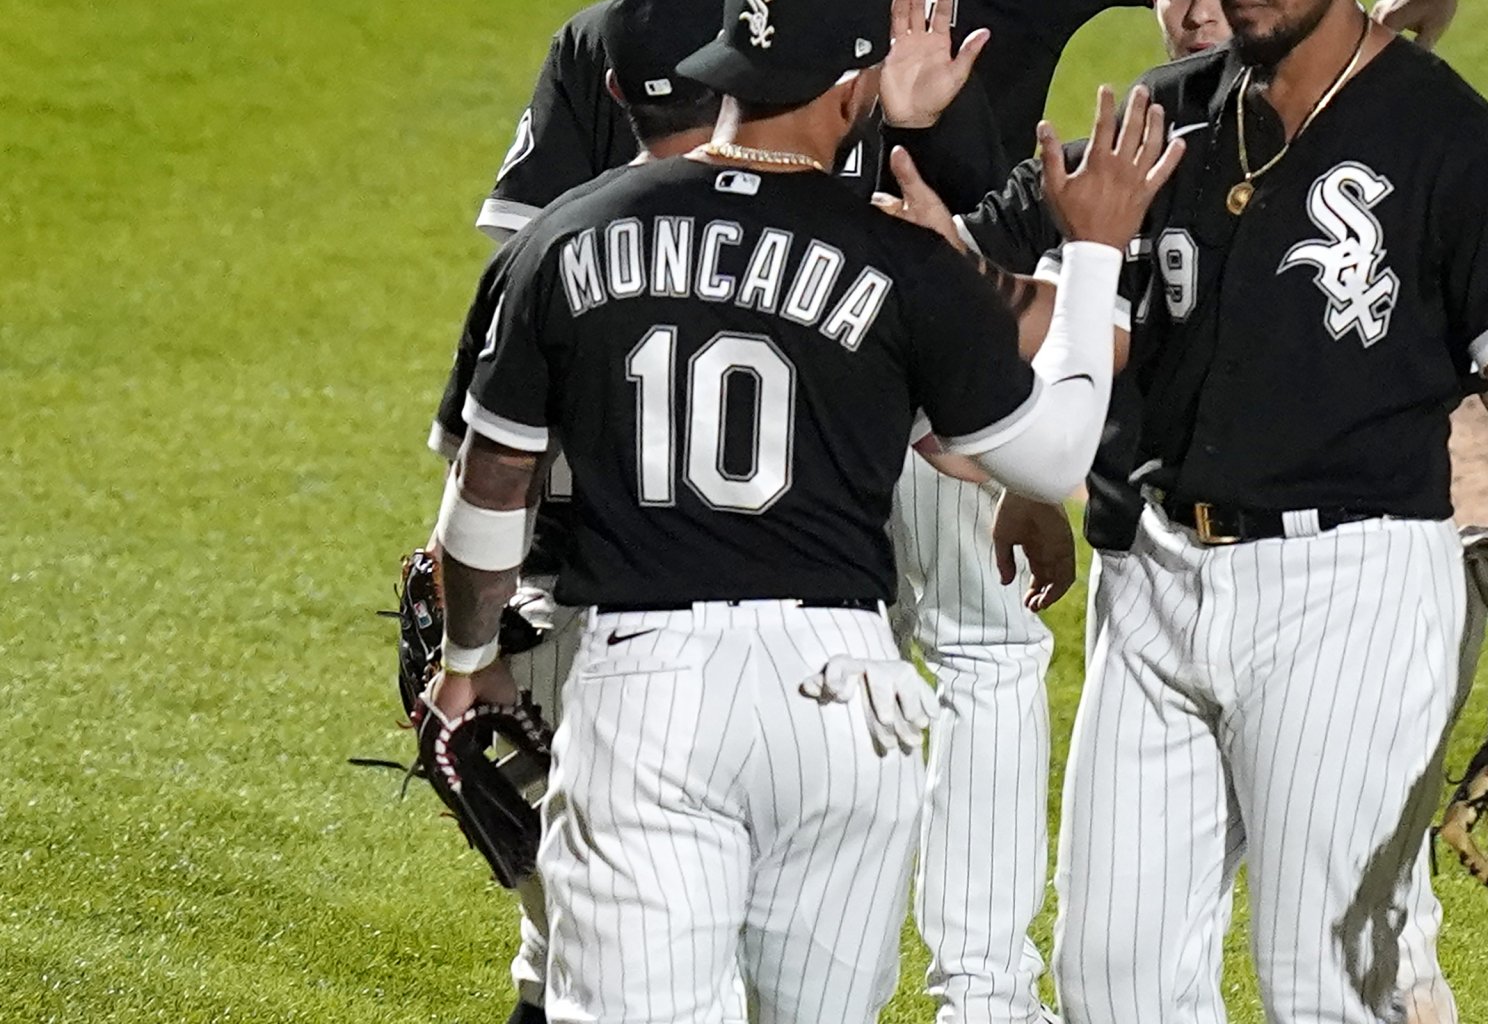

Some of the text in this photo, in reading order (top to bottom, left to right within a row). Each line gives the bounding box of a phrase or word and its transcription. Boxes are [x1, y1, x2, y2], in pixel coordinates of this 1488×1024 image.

[559, 216, 894, 353] MONCADA
[1276, 161, 1400, 349] Sox
[625, 325, 797, 516] 10
